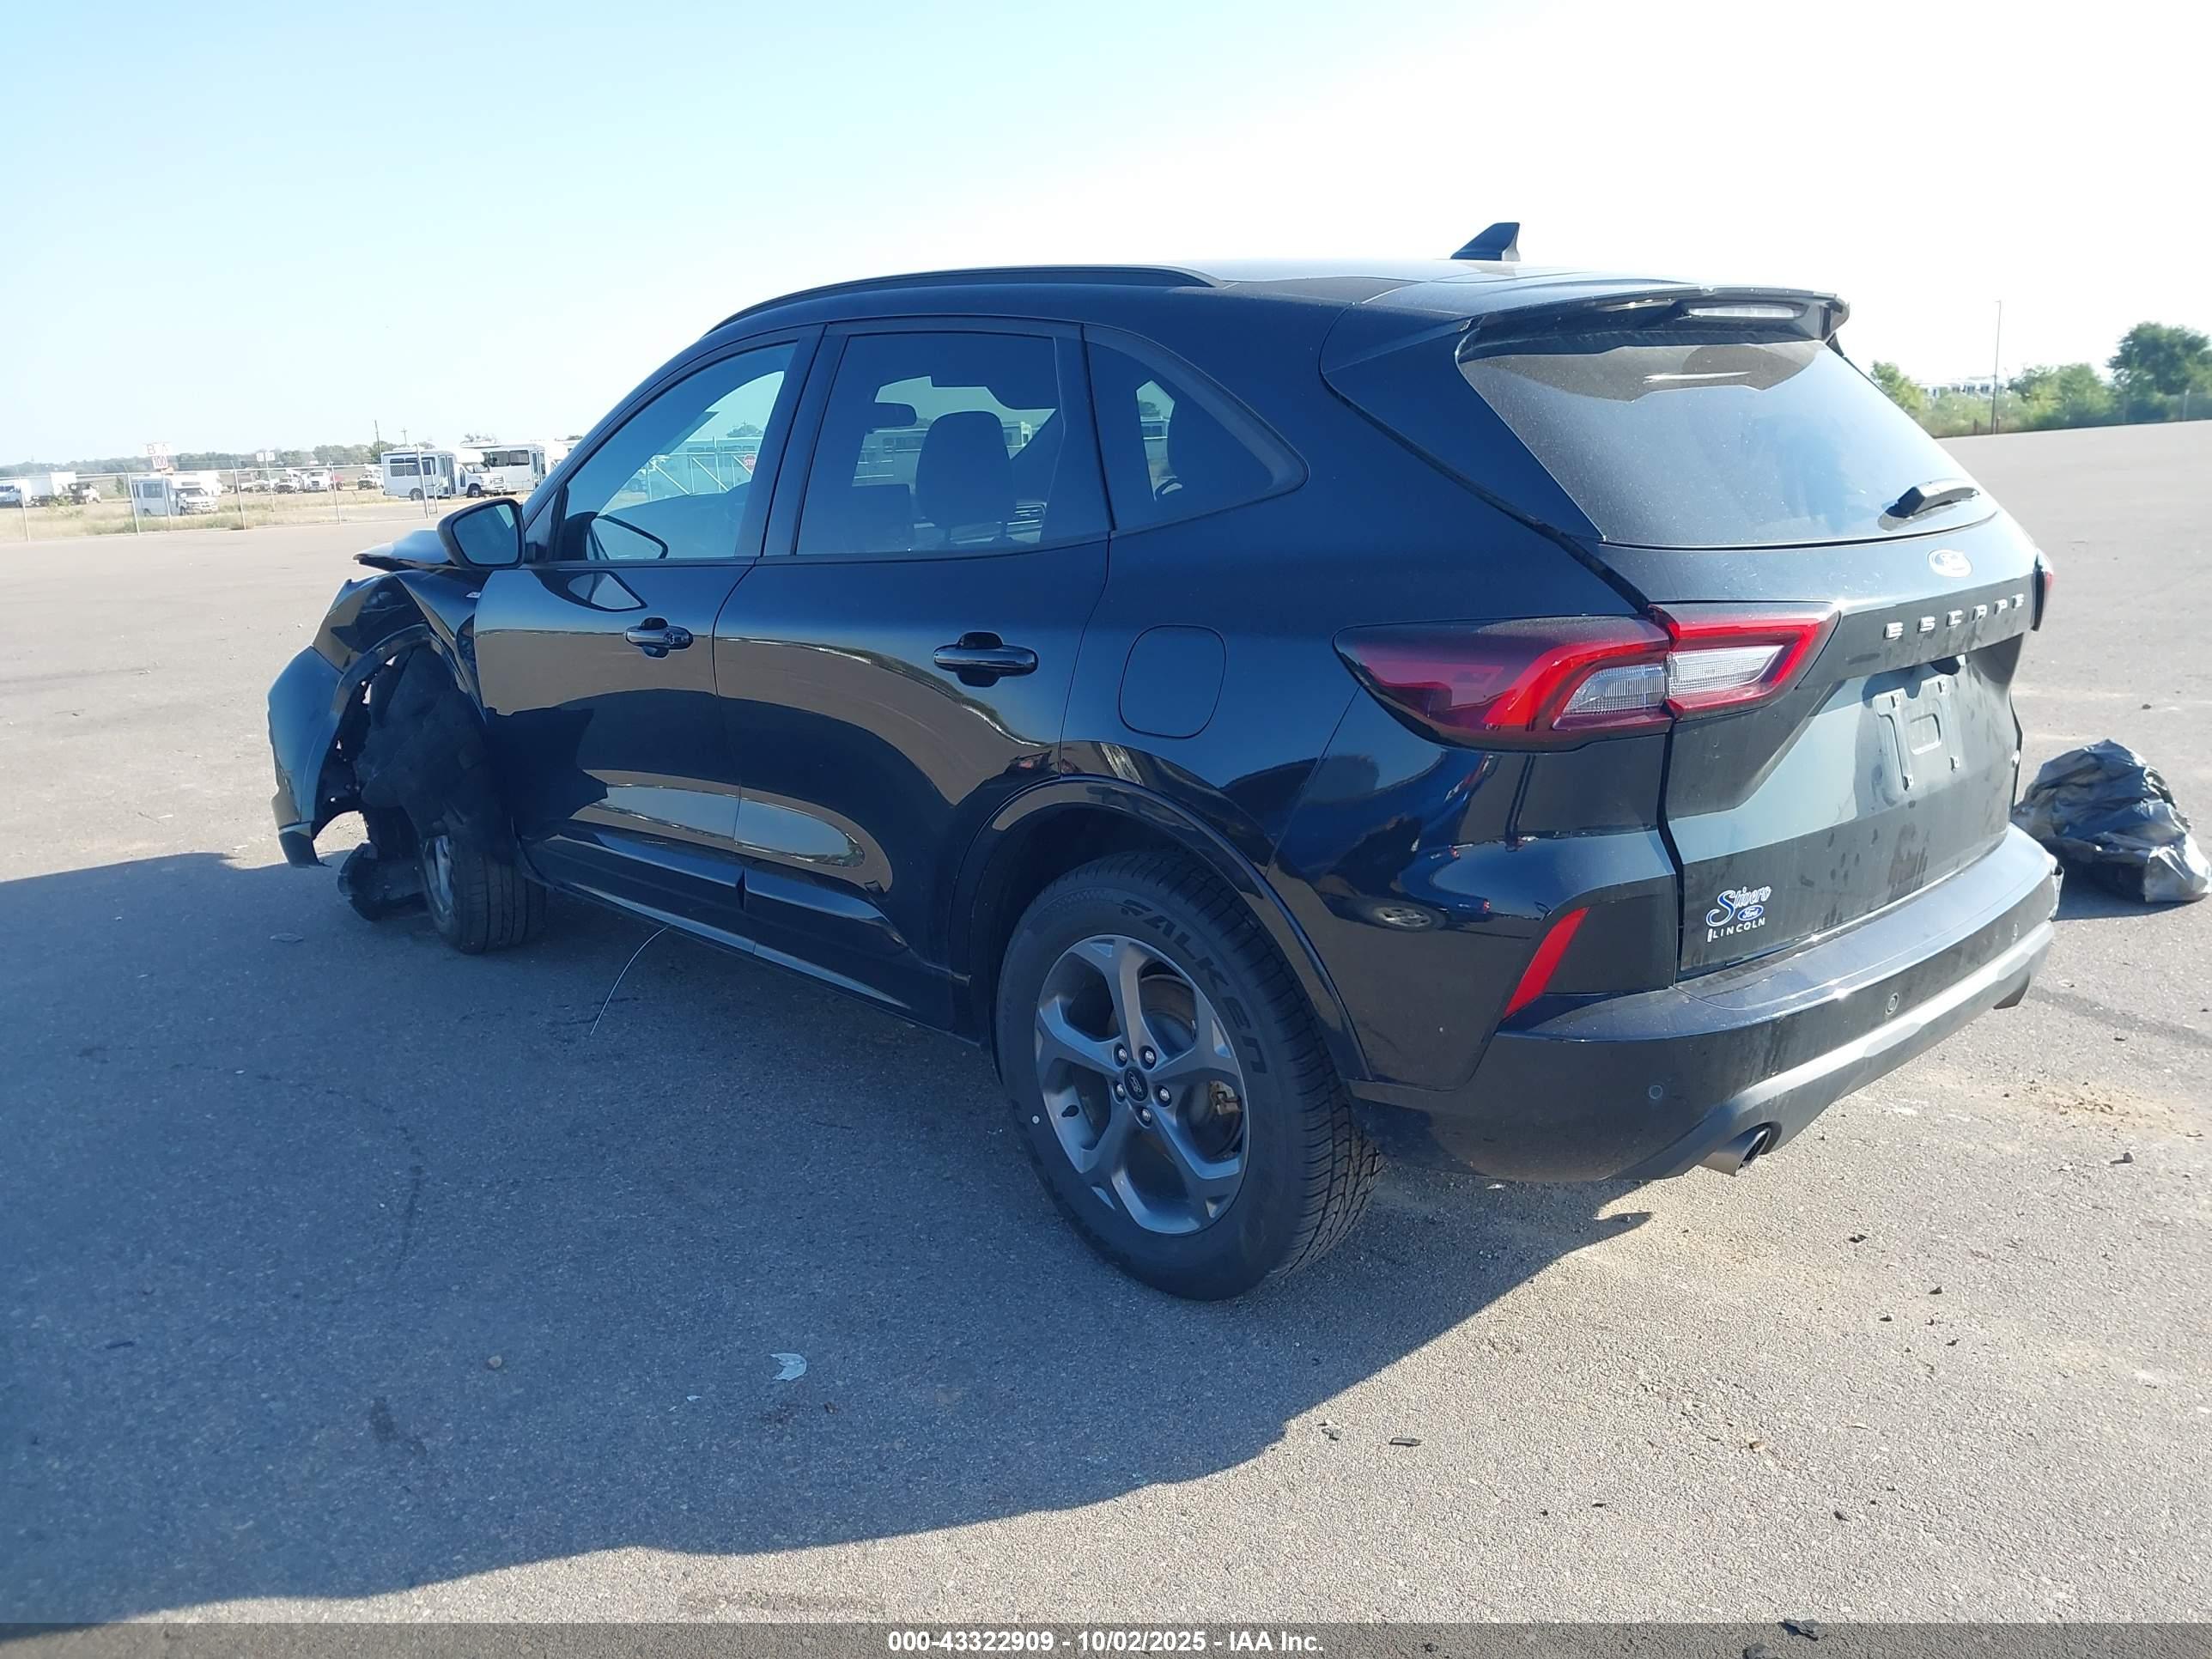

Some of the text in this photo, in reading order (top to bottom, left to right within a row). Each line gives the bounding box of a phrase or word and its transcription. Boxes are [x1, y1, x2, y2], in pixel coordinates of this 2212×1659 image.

[1885, 593, 2025, 639] ESCAPE
[1713, 917, 1765, 939] LINCOLN
[1118, 899, 1267, 1073] FALKEN
